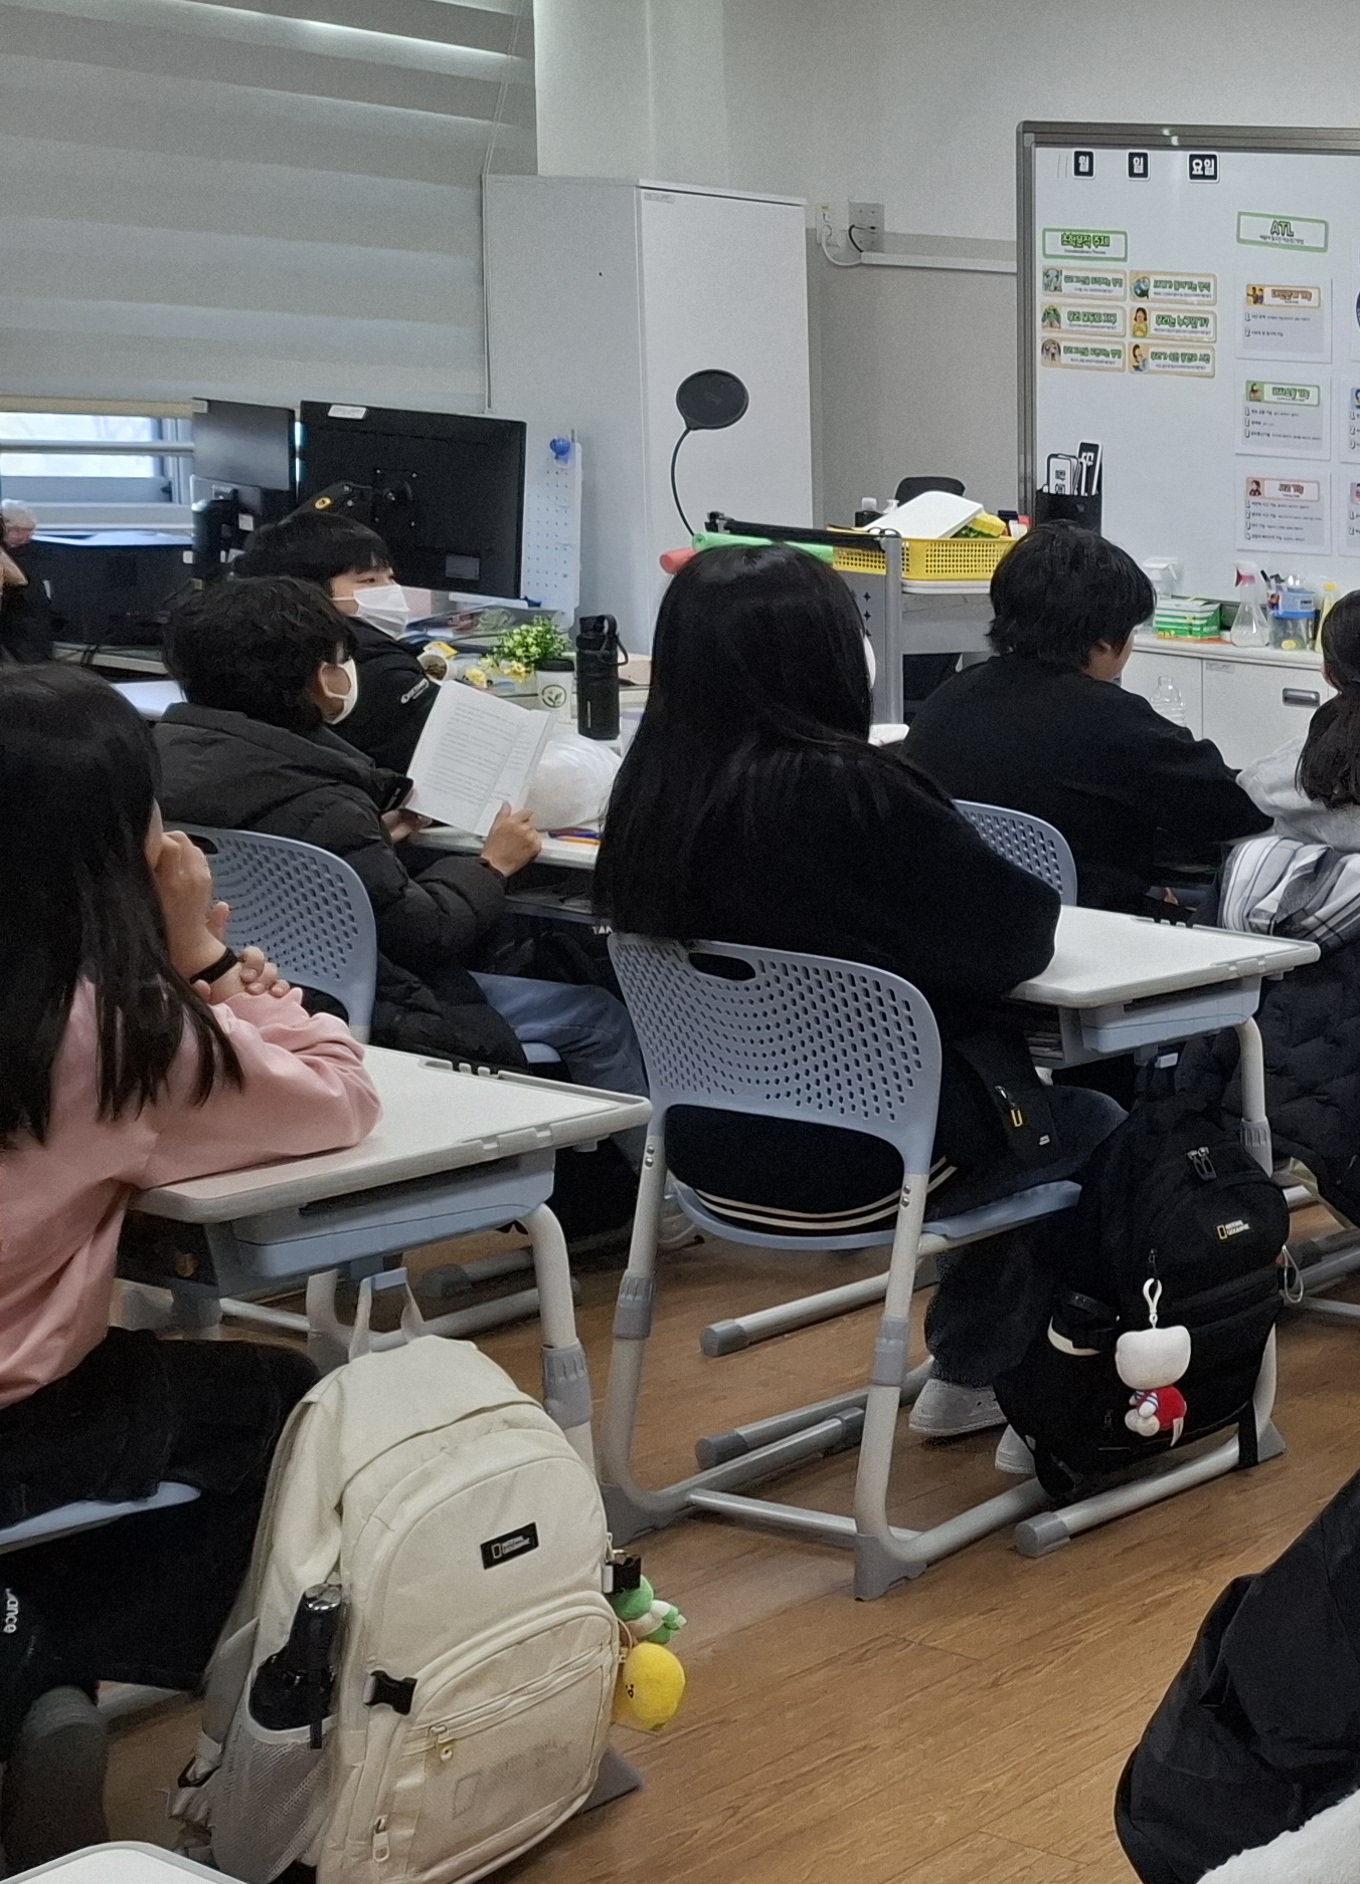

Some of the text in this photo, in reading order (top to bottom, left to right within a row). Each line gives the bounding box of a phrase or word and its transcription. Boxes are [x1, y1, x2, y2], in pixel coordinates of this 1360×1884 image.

[1133, 157, 1143, 173] 일
[1192, 158, 1214, 175] 요일
[1270, 220, 1294, 237] ATL
